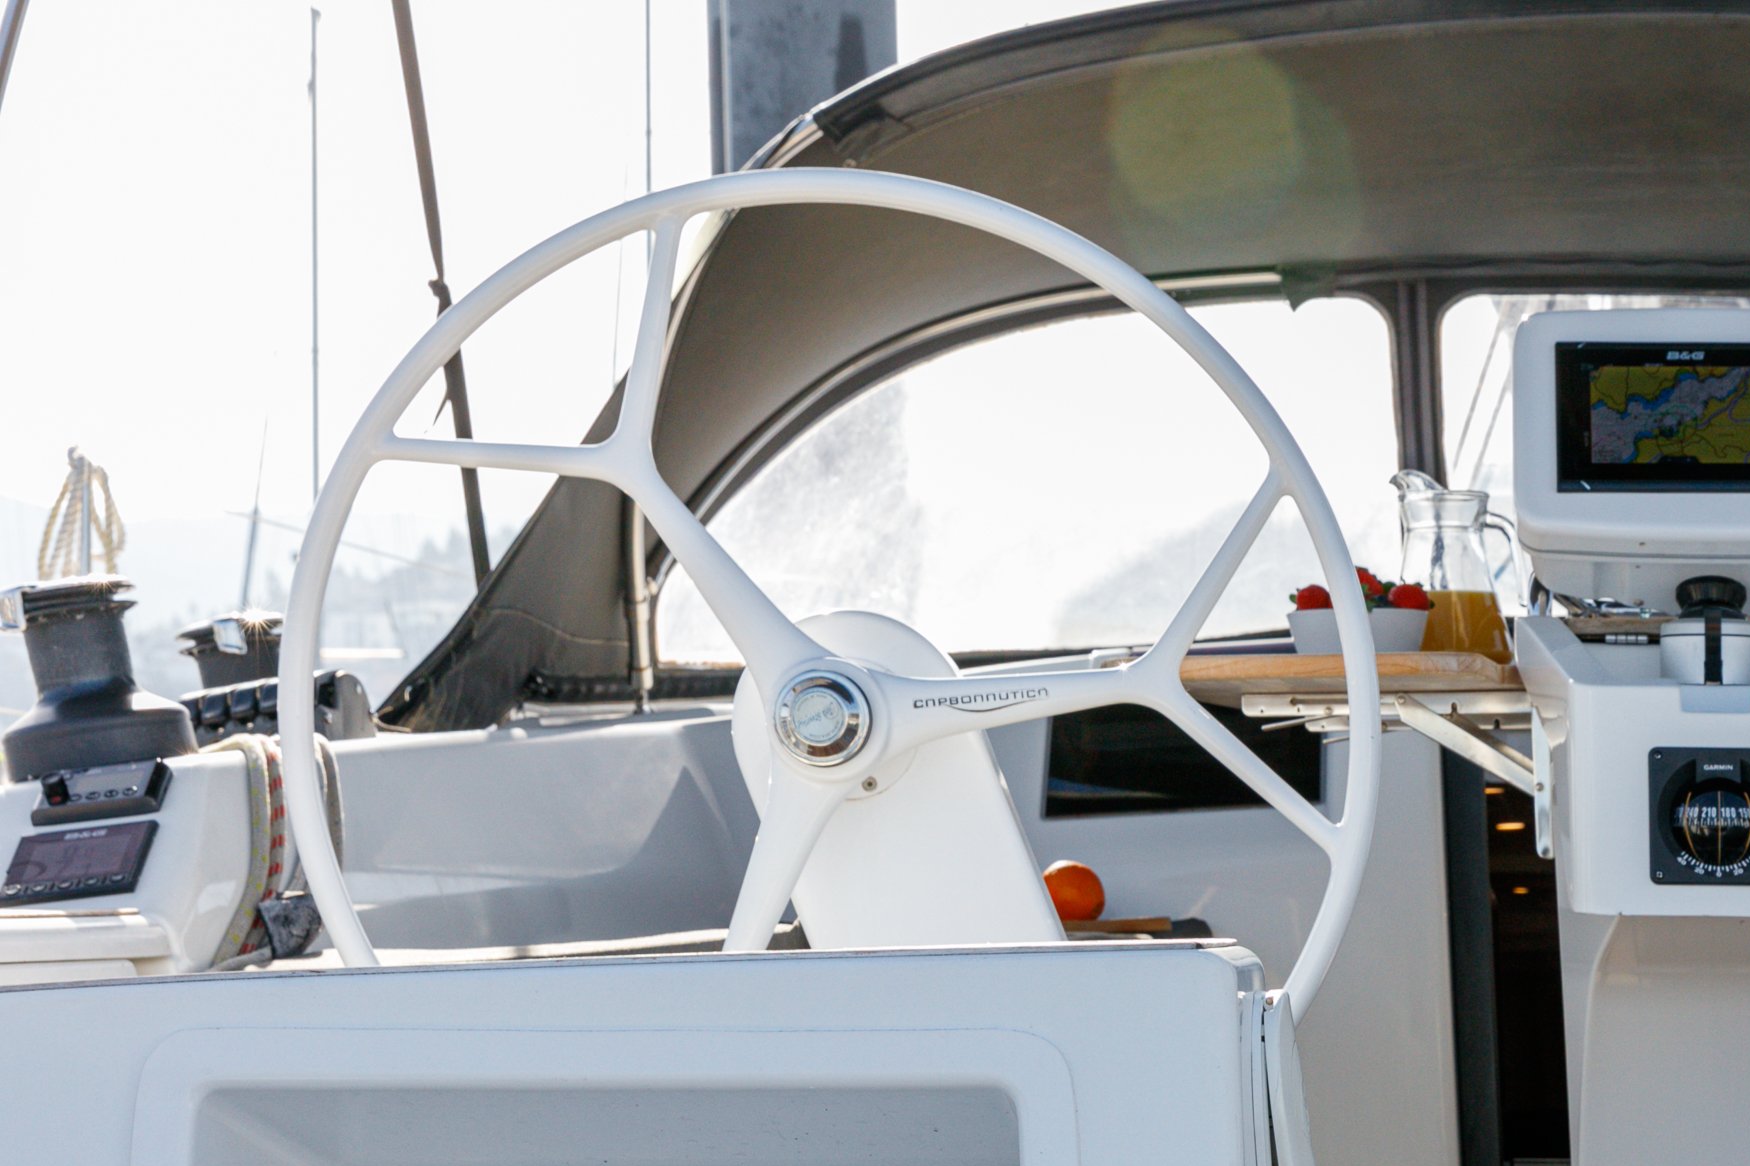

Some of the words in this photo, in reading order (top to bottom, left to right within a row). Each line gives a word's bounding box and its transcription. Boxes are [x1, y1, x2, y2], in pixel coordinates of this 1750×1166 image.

[1666, 350, 1706, 361] B&G
[1701, 807, 1717, 818] 210
[1721, 807, 1737, 819] 180
